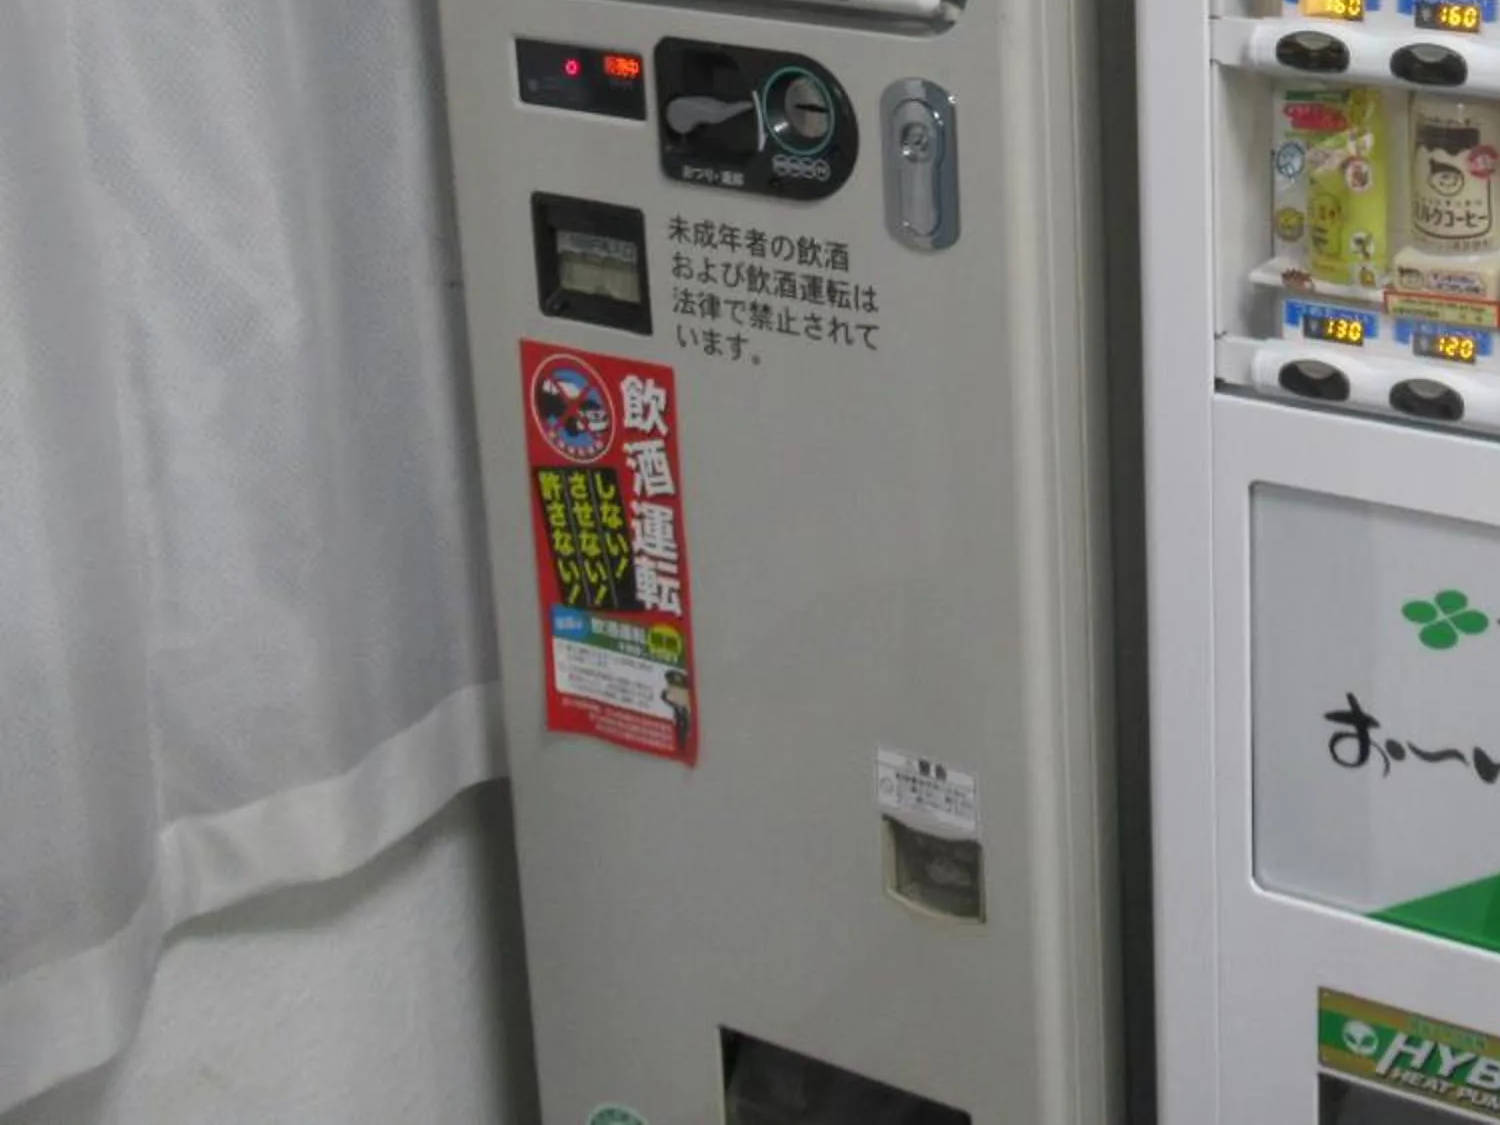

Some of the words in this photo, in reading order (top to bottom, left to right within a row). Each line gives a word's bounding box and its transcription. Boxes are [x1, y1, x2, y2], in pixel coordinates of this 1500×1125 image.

[668, 216, 849, 272] 未成年者の飲酒
[671, 252, 880, 316] および飲酒運転は
[672, 286, 880, 351] 法律で禁止されて
[677, 325, 762, 366] います。
[620, 375, 683, 617] 飲酒運転
[1389, 1069, 1453, 1095] HEAT
